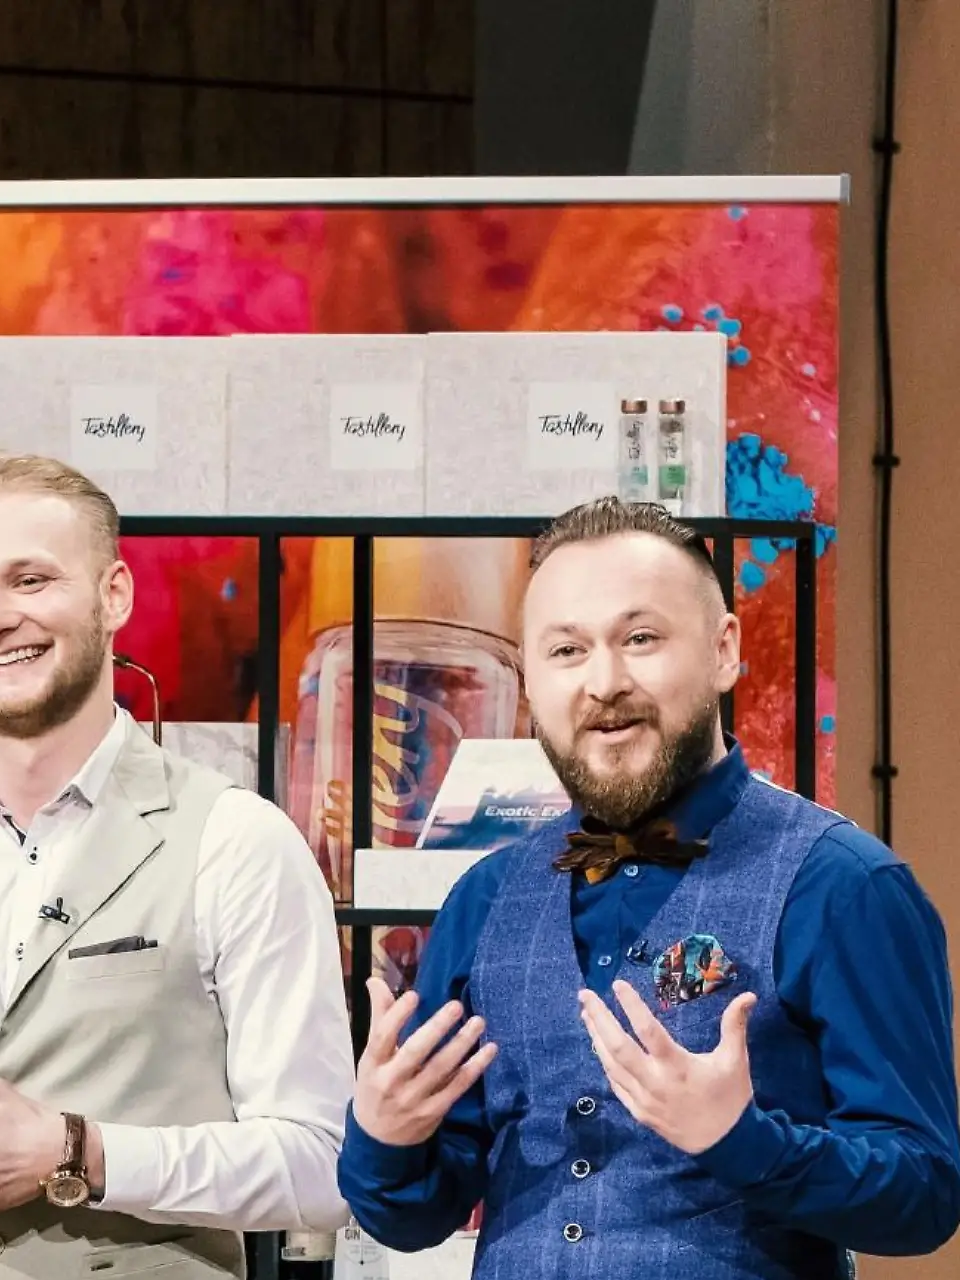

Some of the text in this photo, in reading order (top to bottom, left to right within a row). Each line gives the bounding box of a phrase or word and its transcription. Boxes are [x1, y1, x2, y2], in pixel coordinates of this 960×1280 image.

[81, 413, 146, 441] Tastillery
[340, 412, 406, 441] Tastillery
[539, 411, 605, 440] Tastillery
[484, 805, 537, 817] Exotic
